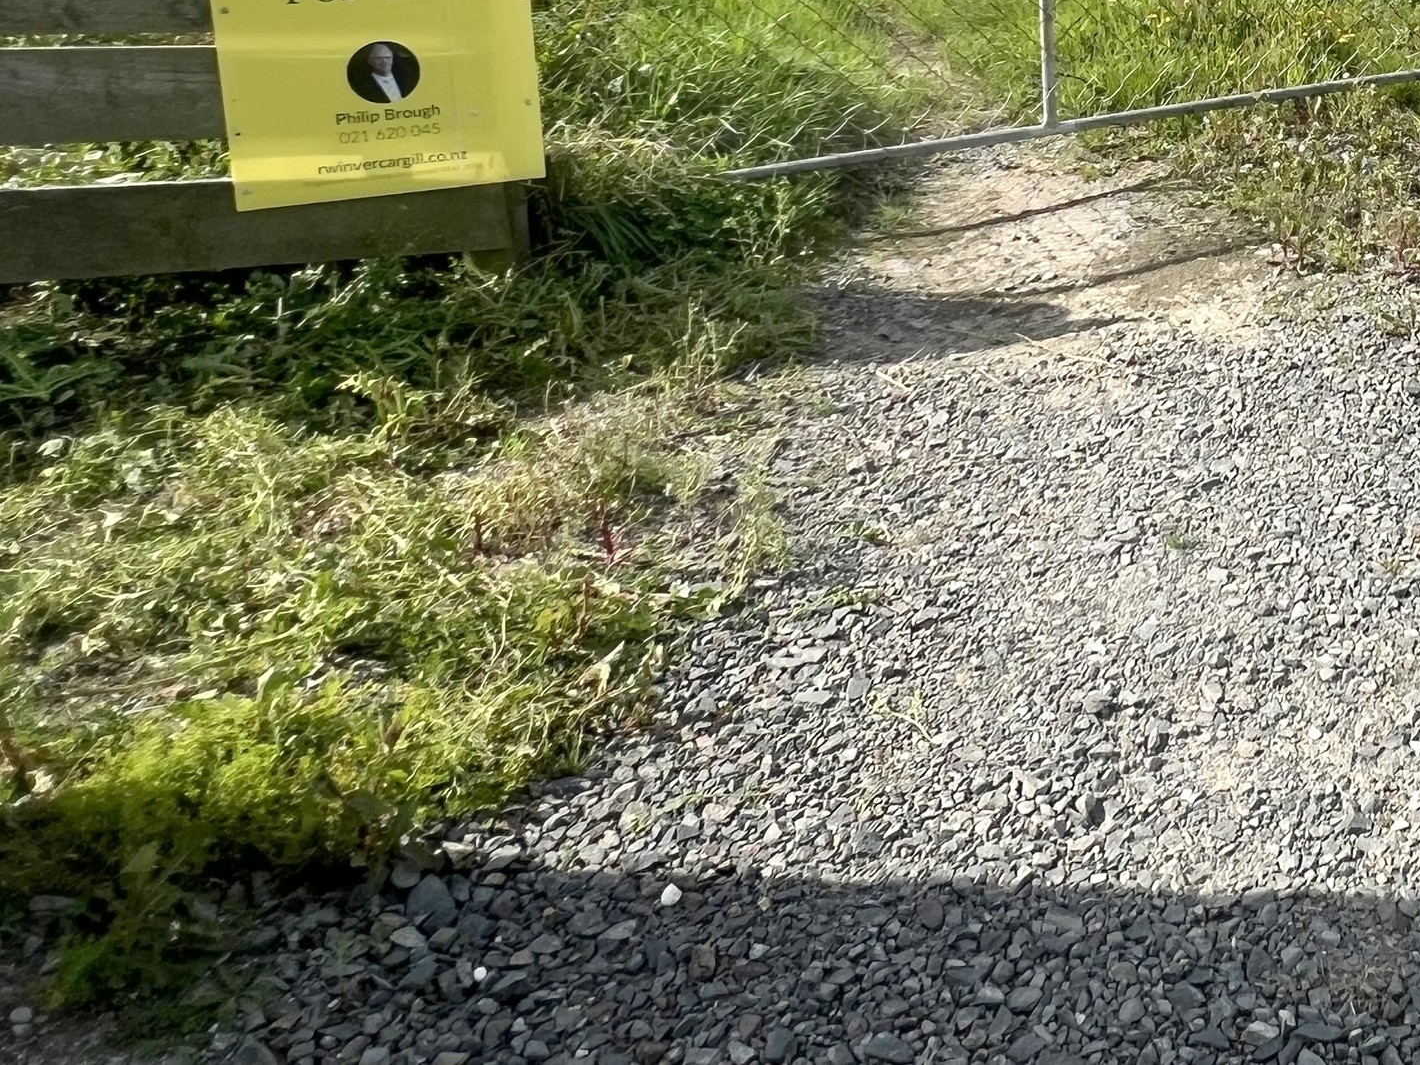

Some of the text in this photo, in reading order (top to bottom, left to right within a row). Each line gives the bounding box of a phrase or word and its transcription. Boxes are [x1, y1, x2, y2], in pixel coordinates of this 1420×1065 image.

[335, 105, 440, 125] Philip Brough
[339, 122, 441, 144] 021 620 045
